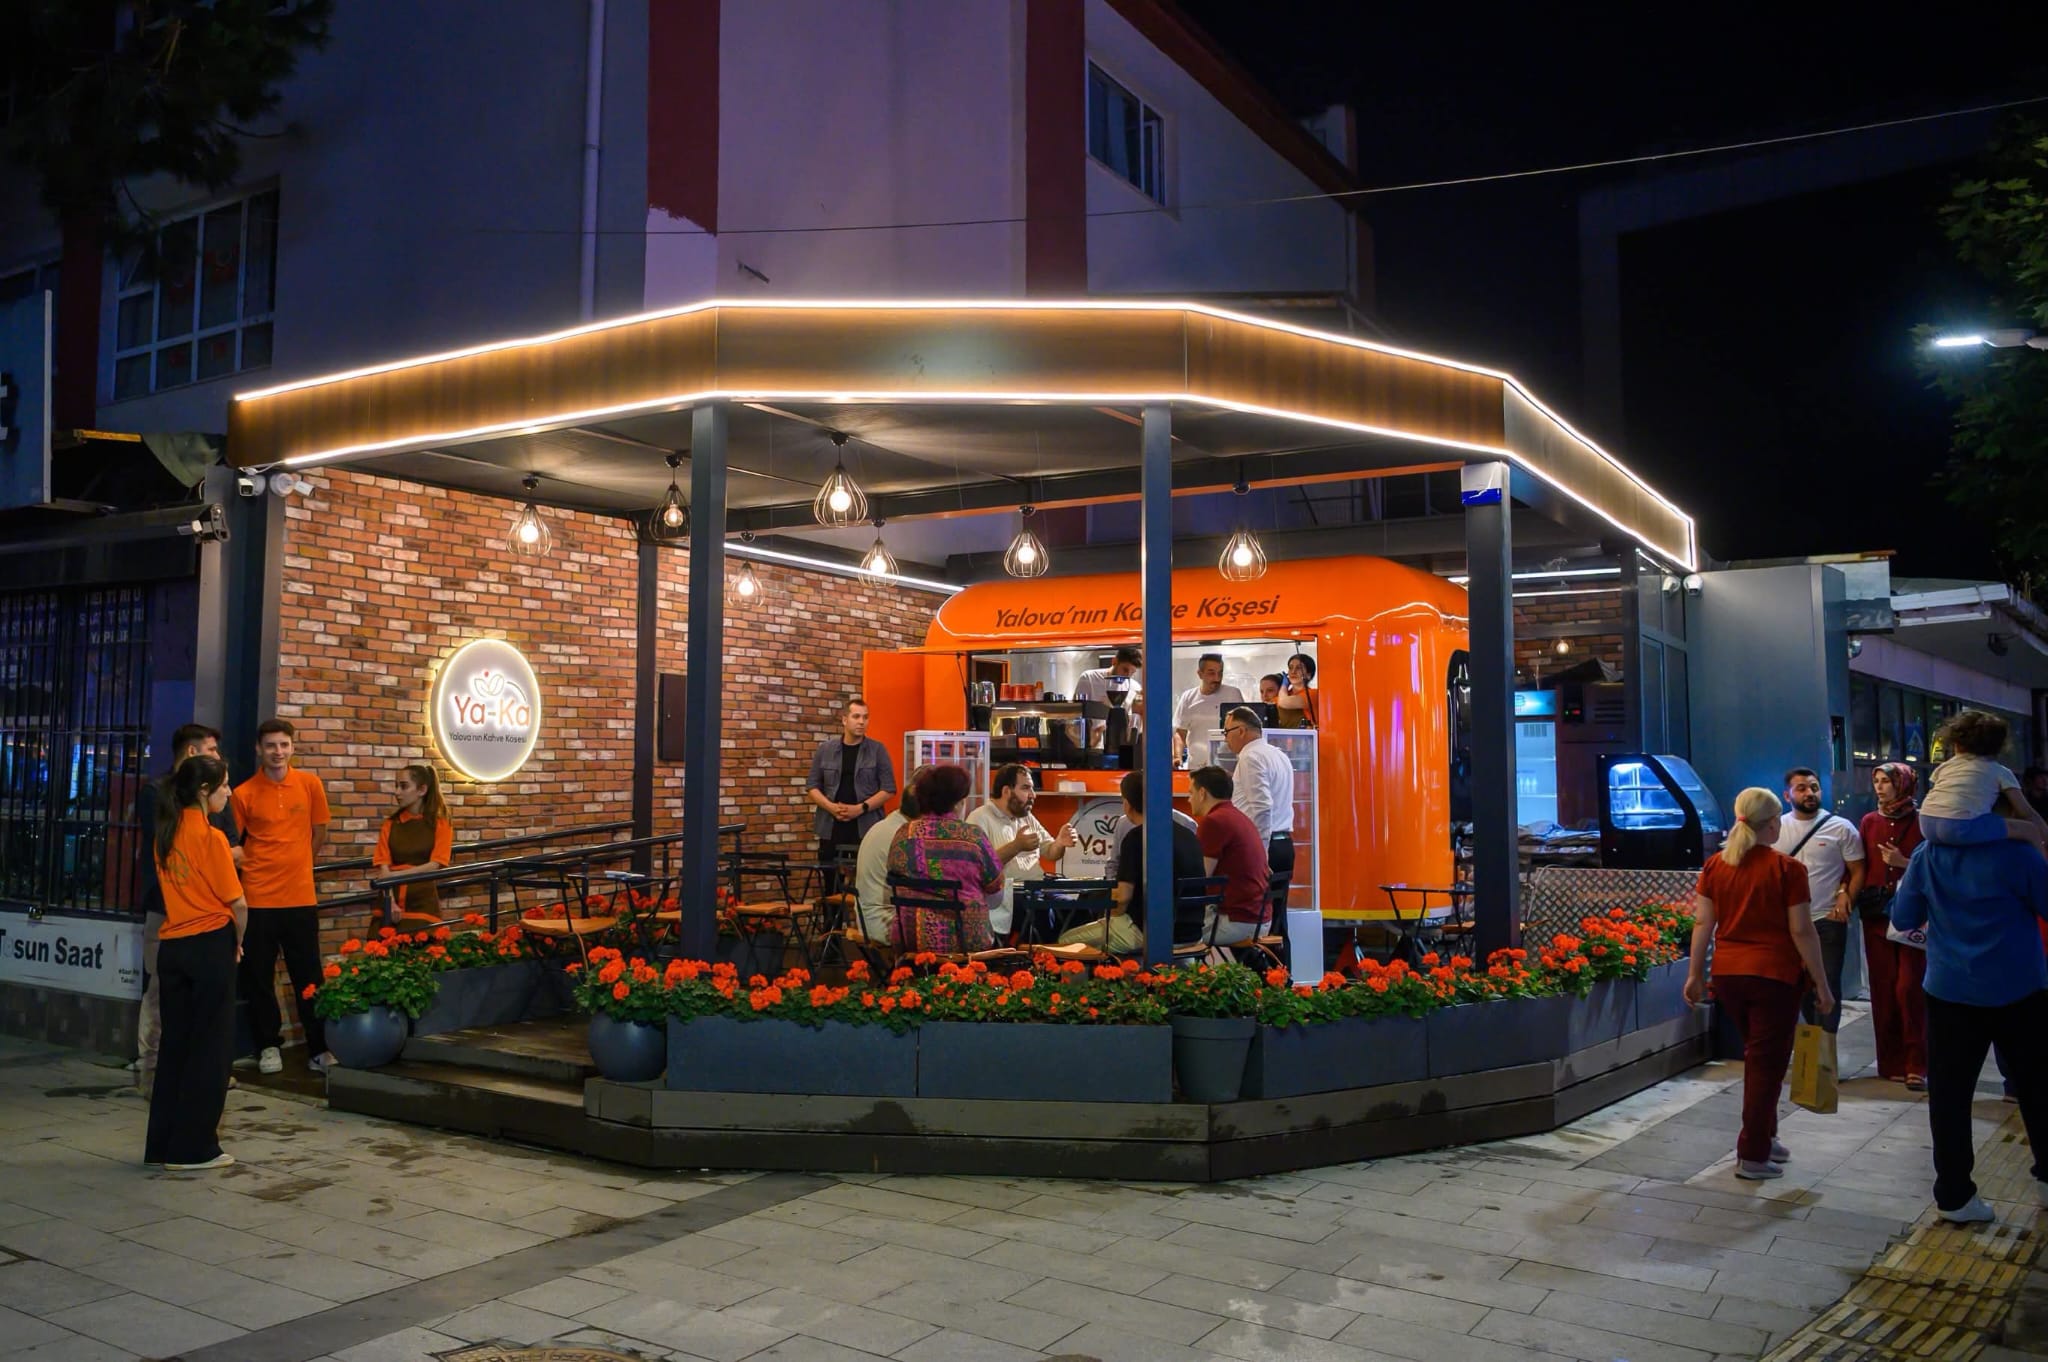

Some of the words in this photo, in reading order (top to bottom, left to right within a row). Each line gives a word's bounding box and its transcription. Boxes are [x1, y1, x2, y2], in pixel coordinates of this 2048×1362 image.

[995, 605, 1108, 628] Yalova'nın
[1113, 602, 1188, 622] Kae
[1196, 595, 1280, 623] Köşesi
[454, 695, 531, 727] Ya-Ka
[483, 732, 504, 743] Kahve
[1078, 834, 1113, 856] Ya-
[0, 928, 49, 963] sun
[54, 936, 104, 969] Saat
